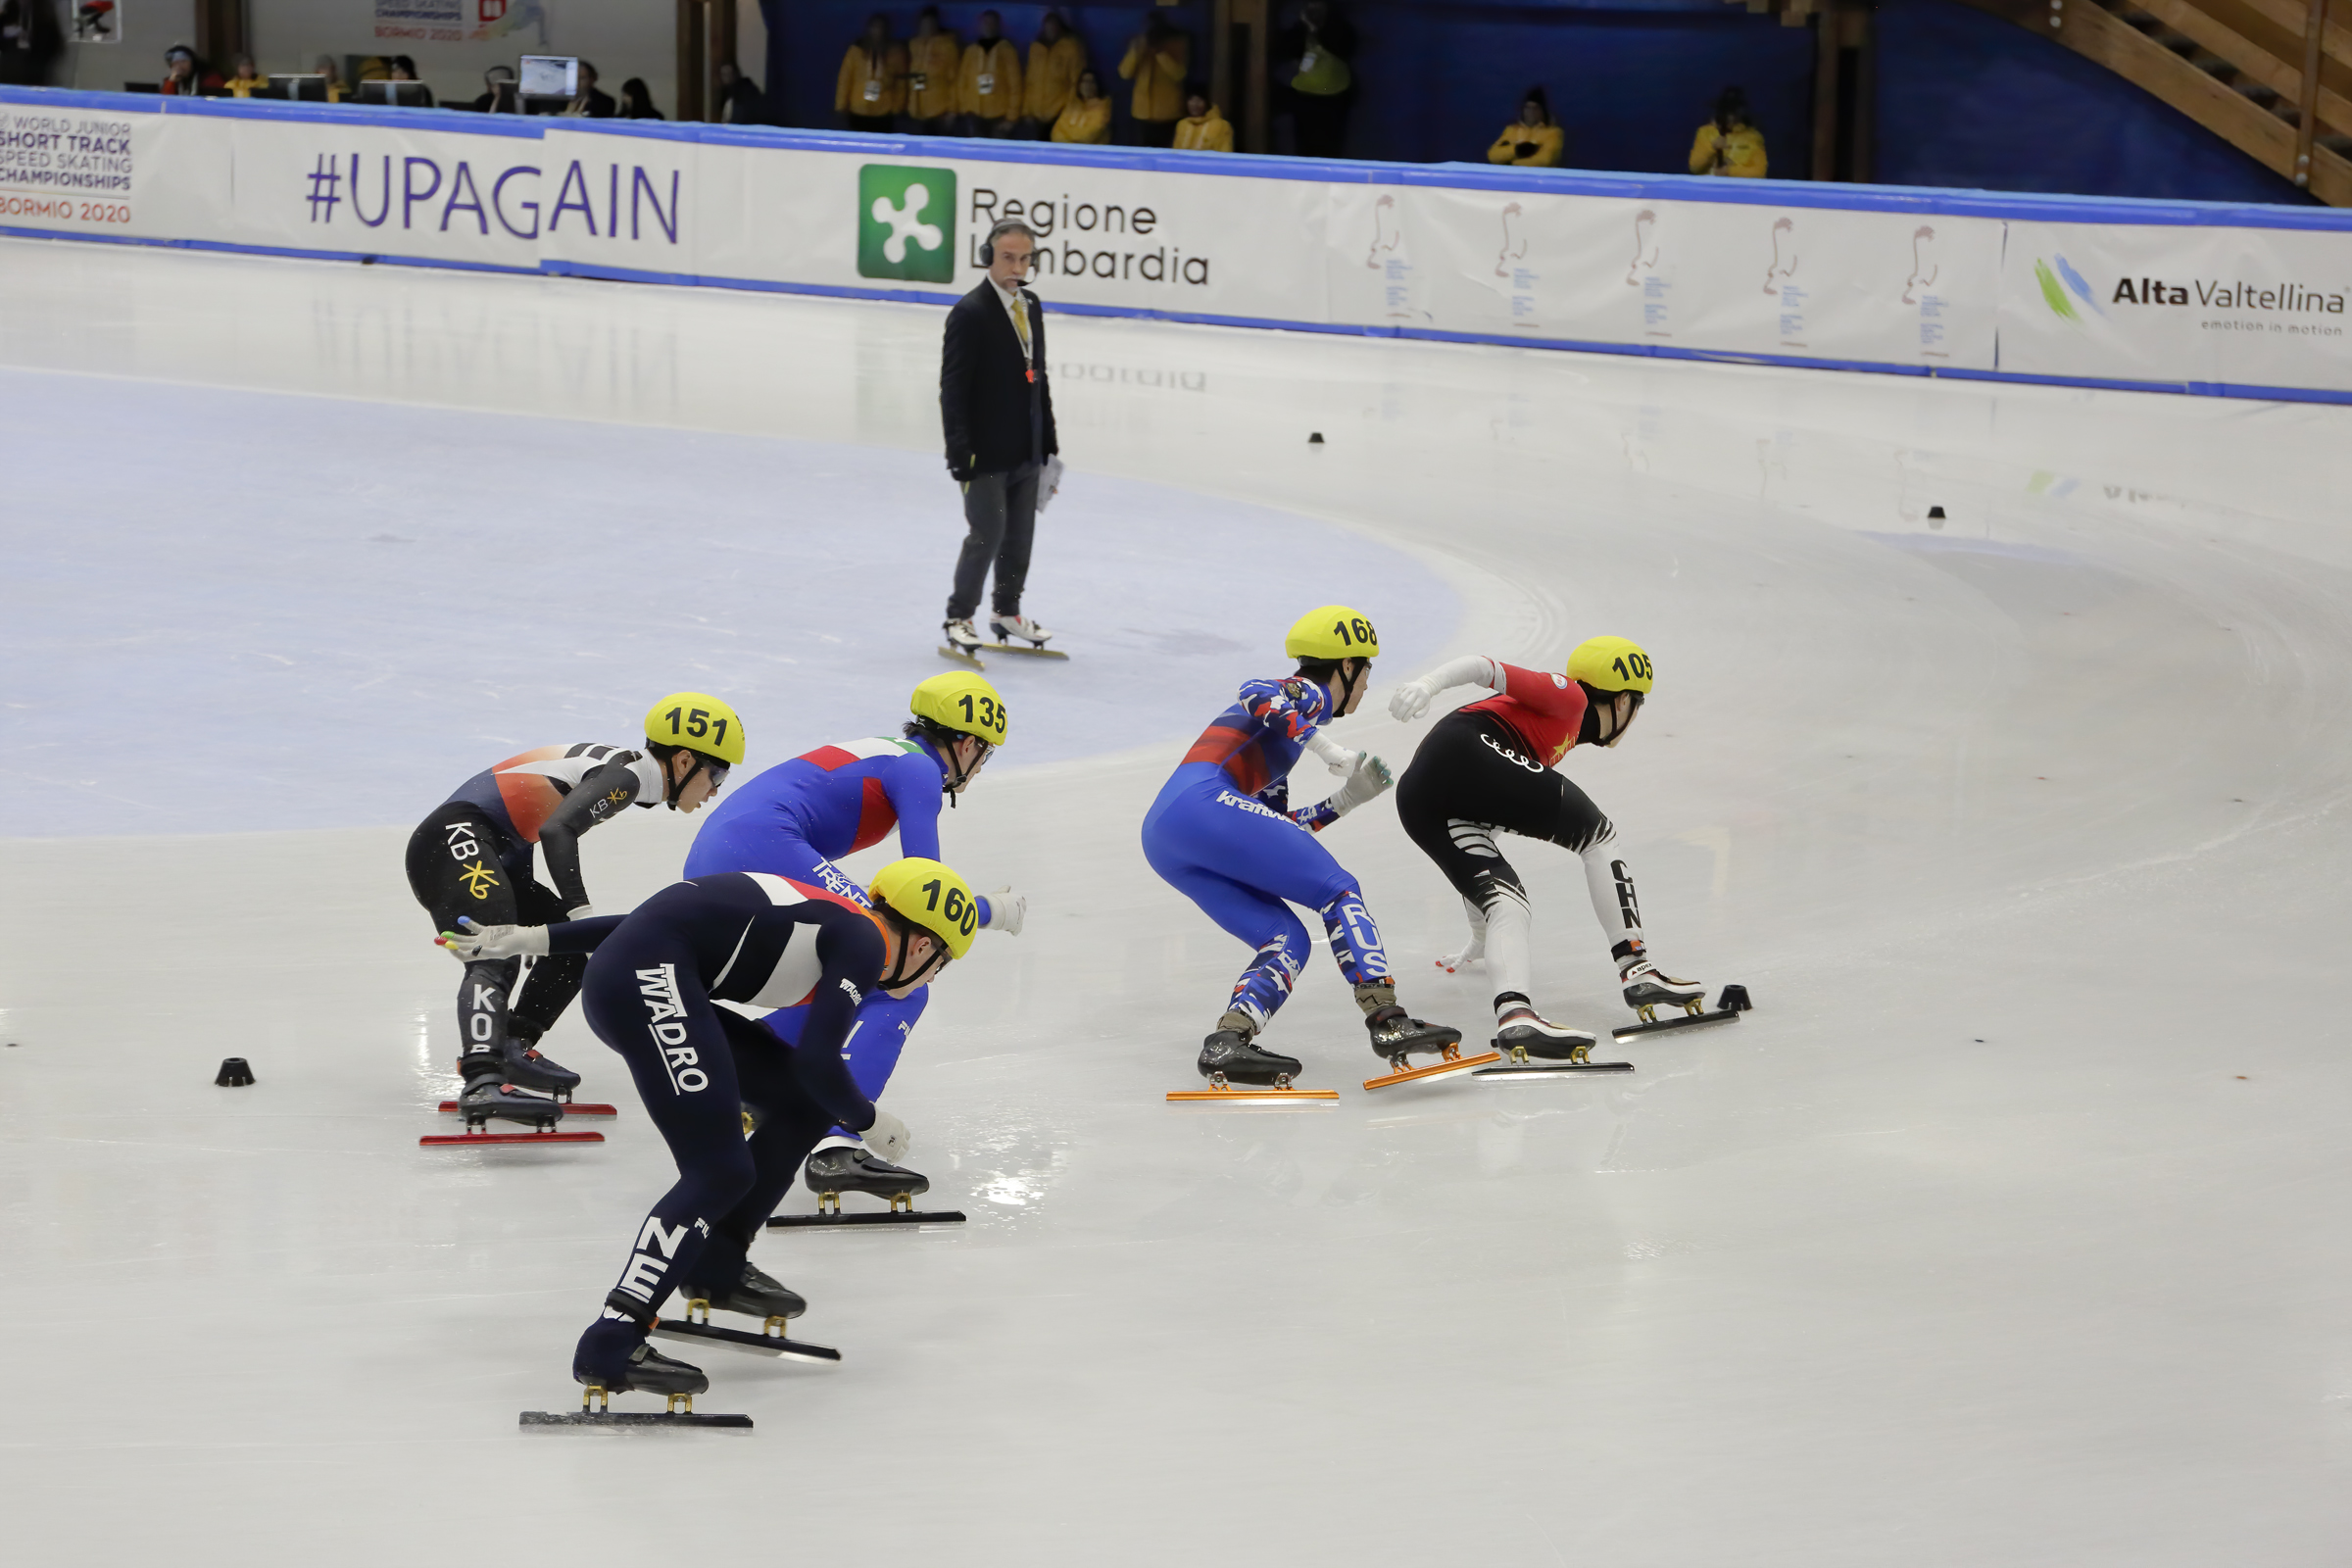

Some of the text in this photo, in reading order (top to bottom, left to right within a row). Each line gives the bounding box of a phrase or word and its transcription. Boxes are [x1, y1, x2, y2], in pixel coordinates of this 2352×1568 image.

[374, 25, 463, 41] BORMIO 2020
[14, 116, 131, 137] WORLD JUNIOR
[67, 135, 130, 156] TRACK
[57, 153, 132, 173] SKATING
[80, 203, 131, 223] 2020
[306, 152, 680, 244] #UPAGAIN
[970, 188, 1157, 238] Regione
[970, 234, 1209, 285] Lmbardia
[2112, 277, 2344, 315] Alta Valtellina
[2201, 319, 2343, 337] emotion in motion
[1334, 617, 1378, 647] 168
[1612, 653, 1653, 682] 105
[665, 707, 728, 747] 151
[958, 694, 1006, 734] 135
[922, 879, 976, 937] 160
[1610, 859, 1642, 929] CHN
[1342, 904, 1391, 977] RUS
[635, 963, 709, 1096] WADRO
